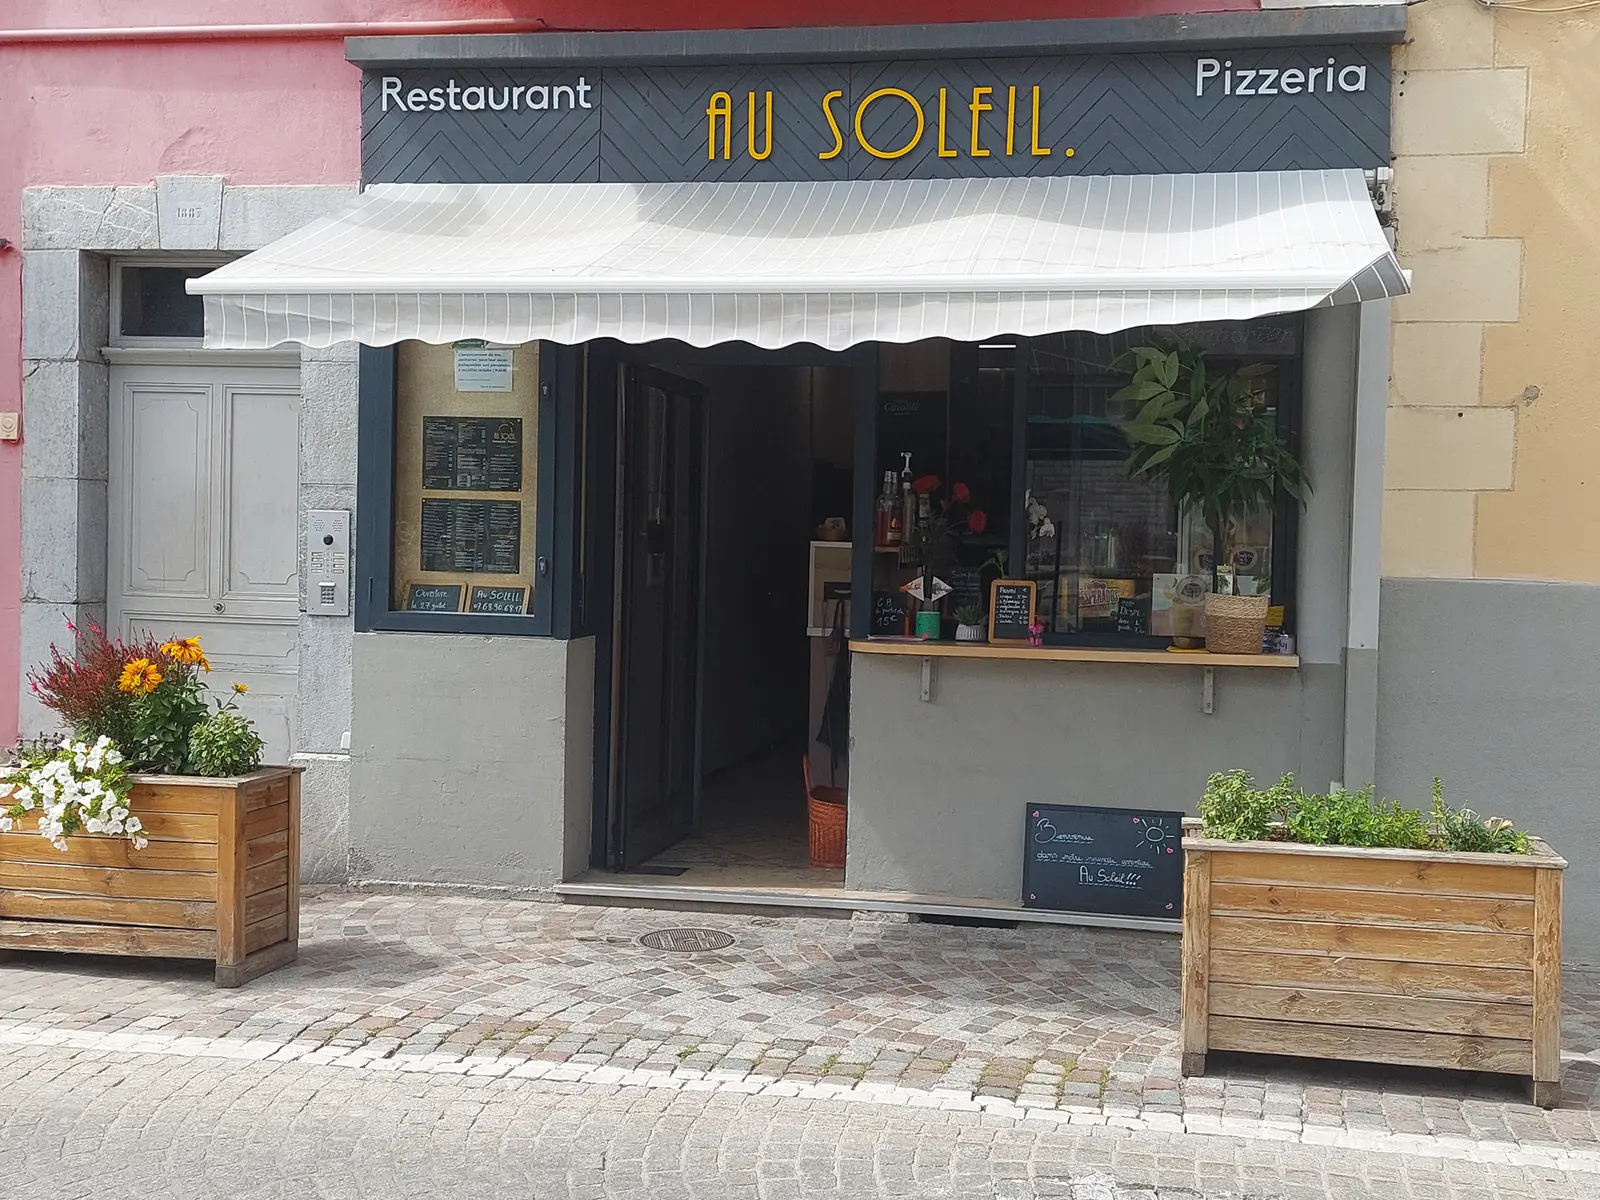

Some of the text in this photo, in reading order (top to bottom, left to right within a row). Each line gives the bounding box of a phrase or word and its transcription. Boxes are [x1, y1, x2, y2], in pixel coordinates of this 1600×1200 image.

[1196, 57, 1367, 97] Pizzeria
[381, 76, 592, 112] Restaurant
[706, 86, 1076, 161] AU SOLEIL.
[420, 601, 430, 609] 27
[477, 590, 488, 598] Au
[1080, 865, 1094, 883] Au
